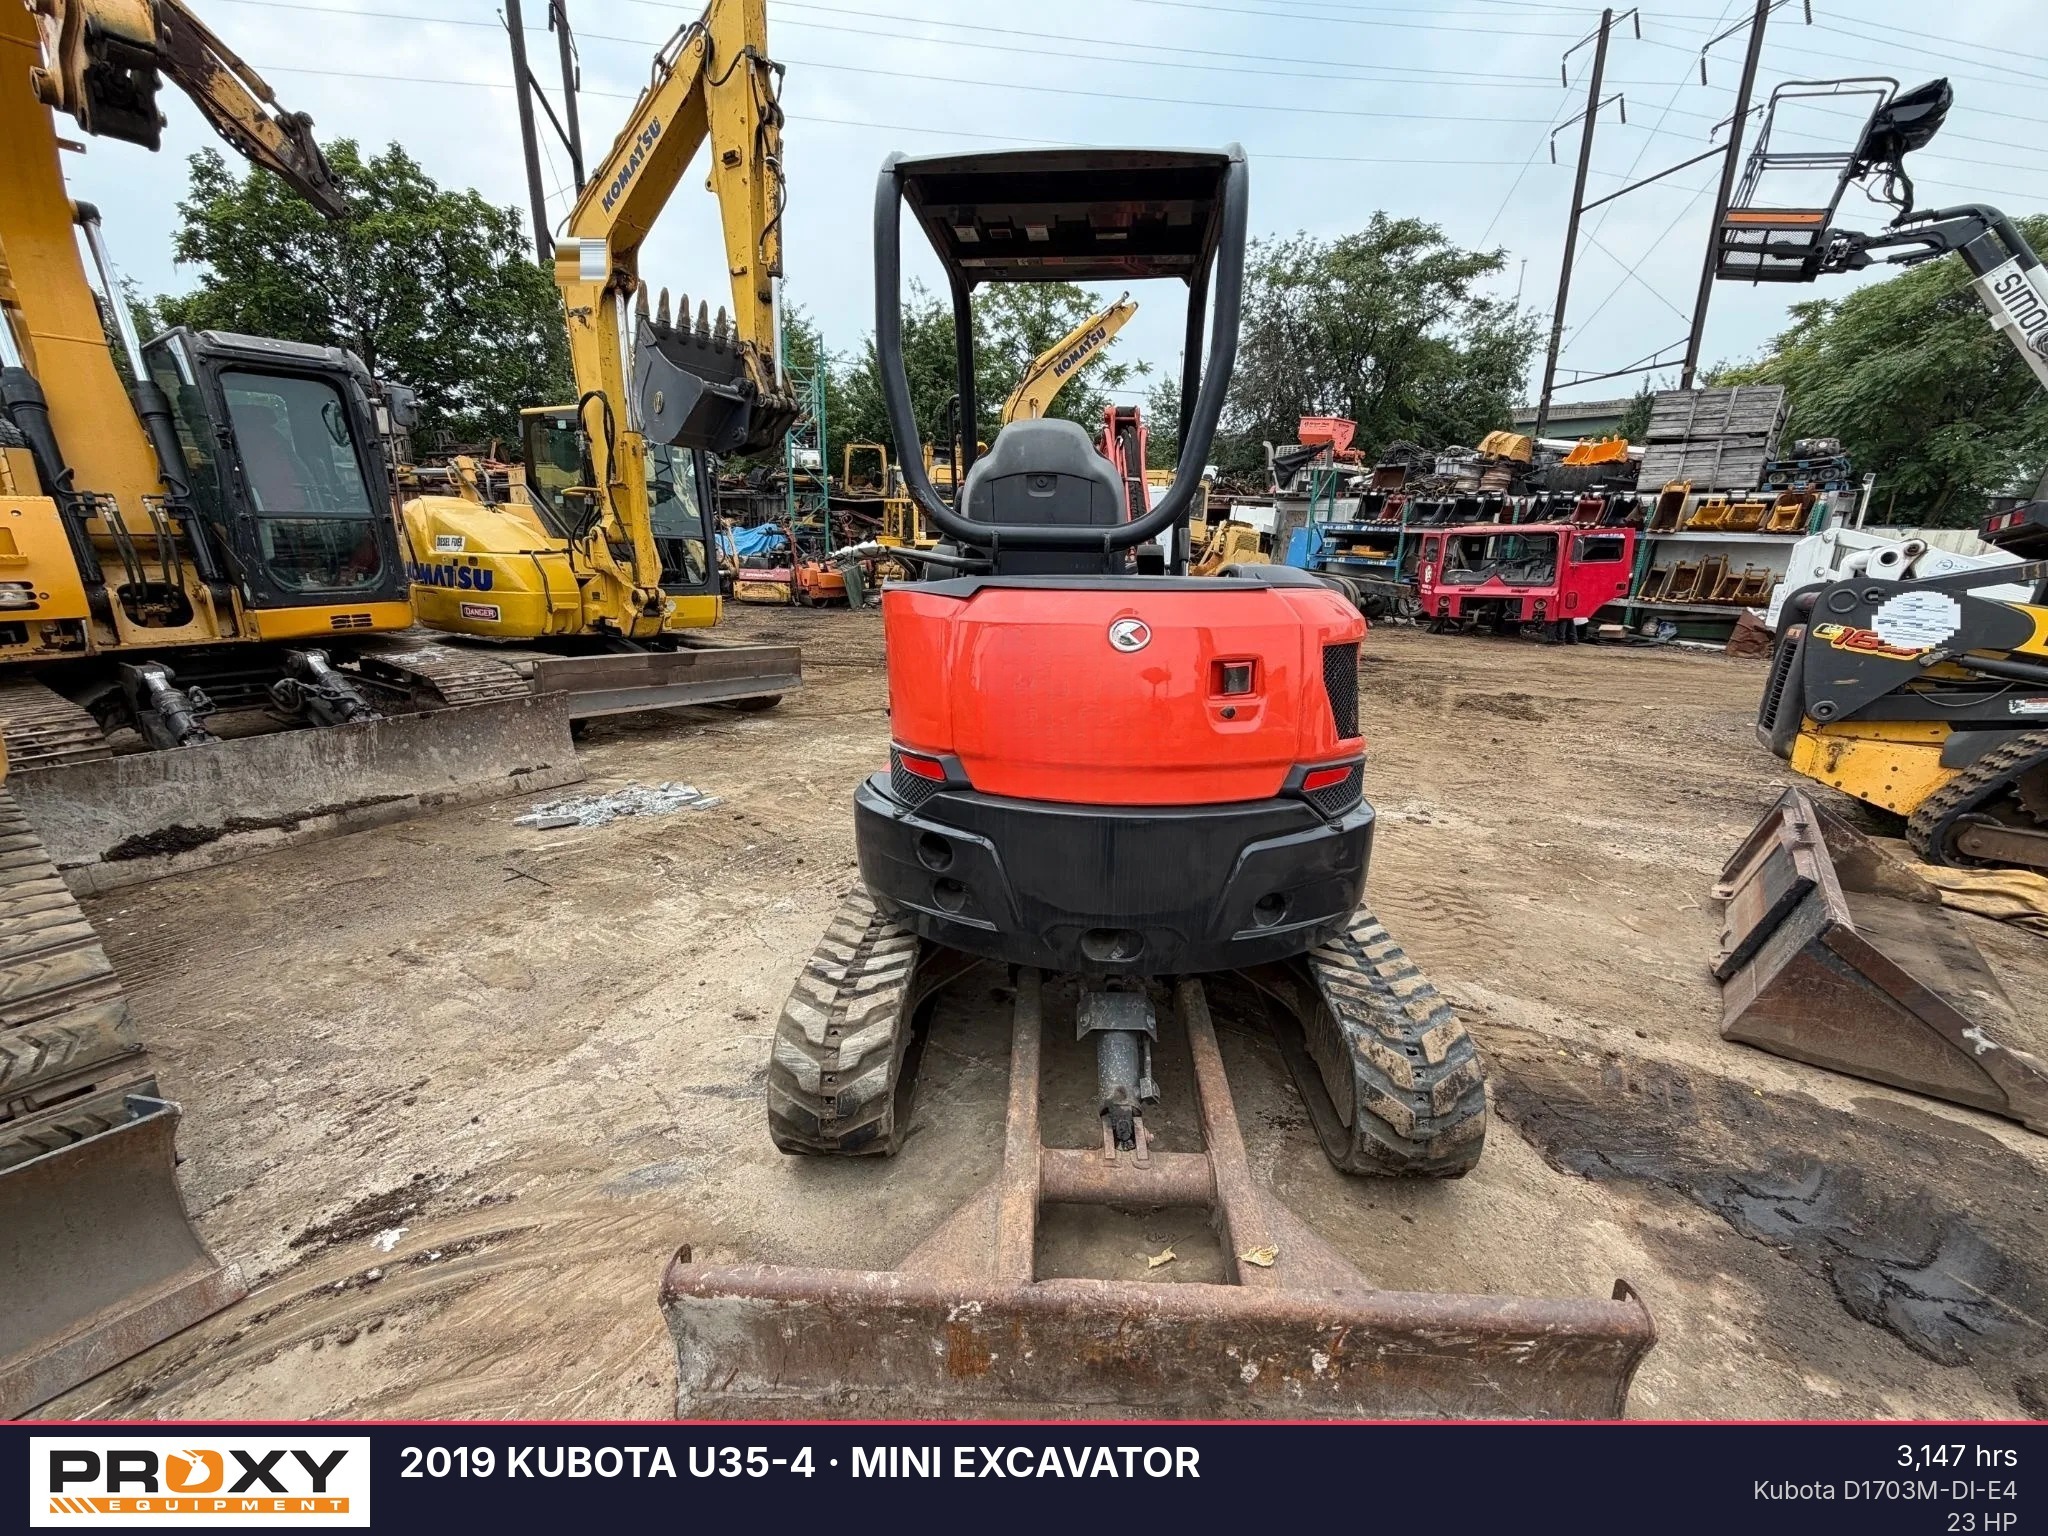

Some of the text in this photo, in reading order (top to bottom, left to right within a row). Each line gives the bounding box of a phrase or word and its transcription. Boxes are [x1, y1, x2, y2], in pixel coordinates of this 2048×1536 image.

[602, 116, 661, 214] KOMATSU
[1053, 327, 1106, 377] KOMATSU
[436, 537, 463, 547] DIESEL FUEL
[465, 606, 494, 617] DANGER
